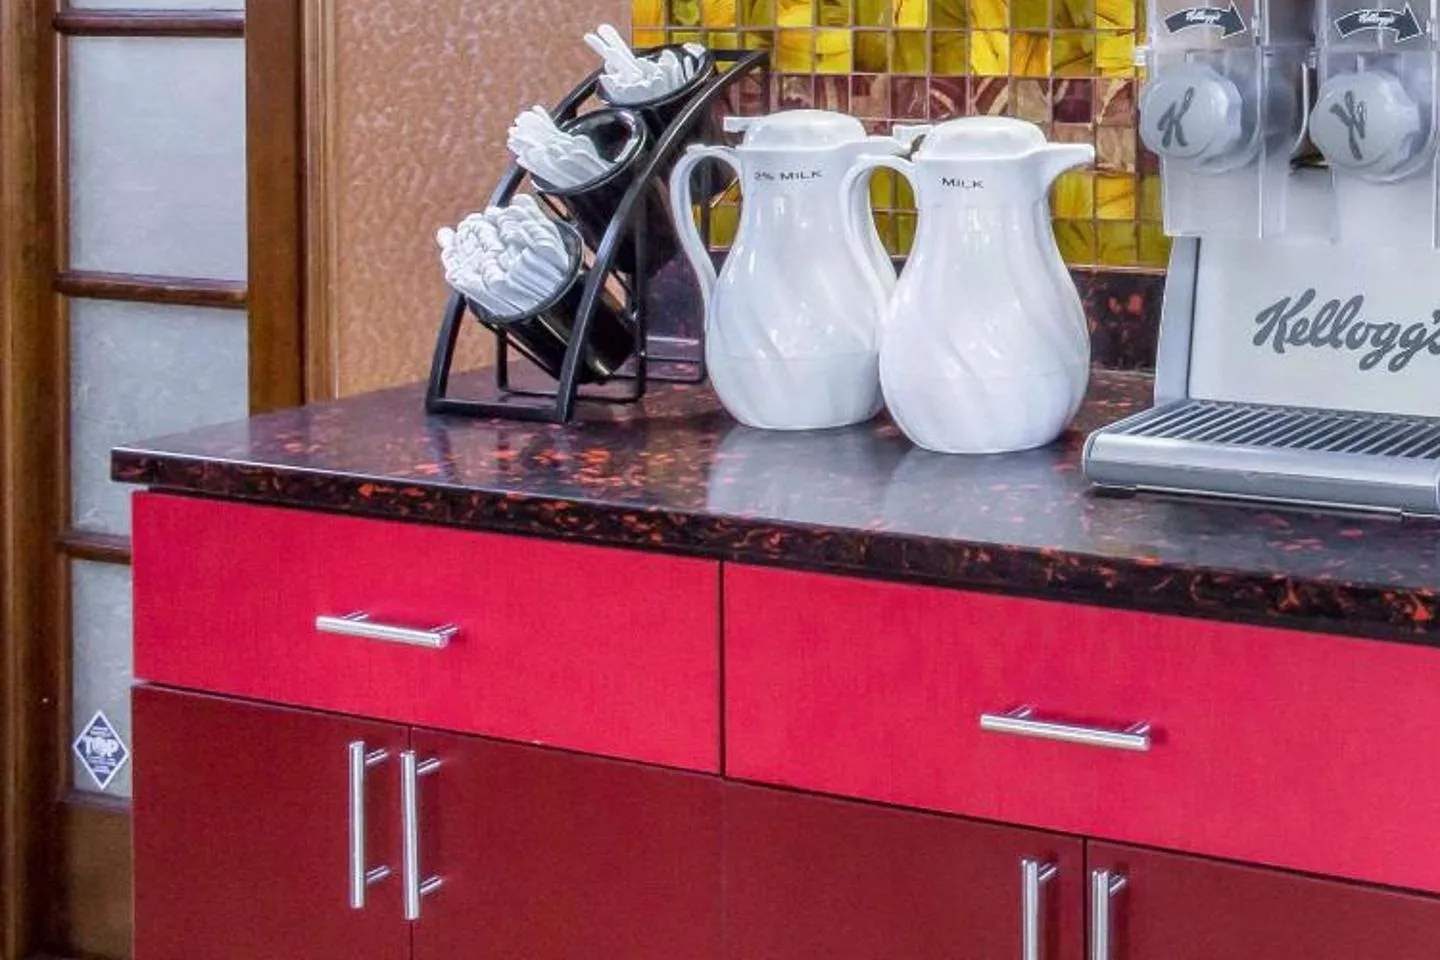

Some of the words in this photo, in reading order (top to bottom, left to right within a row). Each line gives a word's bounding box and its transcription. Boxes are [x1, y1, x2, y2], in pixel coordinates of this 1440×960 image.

[754, 172, 775, 182] 2%
[780, 170, 823, 182] MILK
[941, 177, 984, 190] MILK
